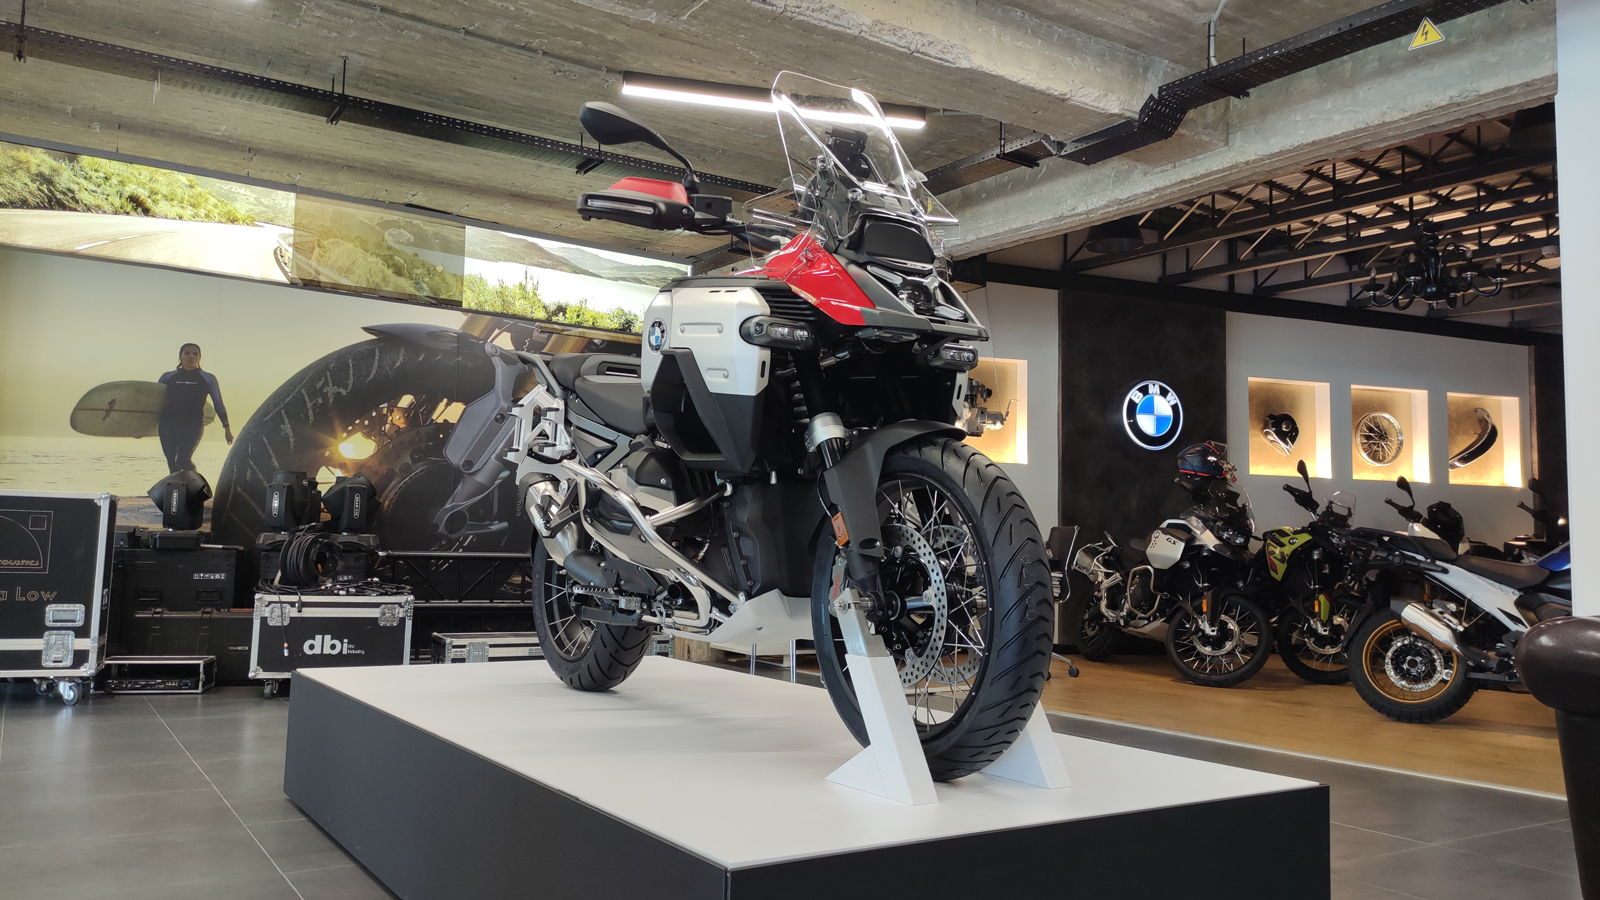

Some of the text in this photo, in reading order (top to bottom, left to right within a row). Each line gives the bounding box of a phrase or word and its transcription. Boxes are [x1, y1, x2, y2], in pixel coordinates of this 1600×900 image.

[1129, 383, 1178, 406] BMW
[1166, 537, 1178, 546] GS
[15, 586, 58, 602] Low
[831, 571, 841, 599] BMW
[303, 634, 349, 655] dbi
